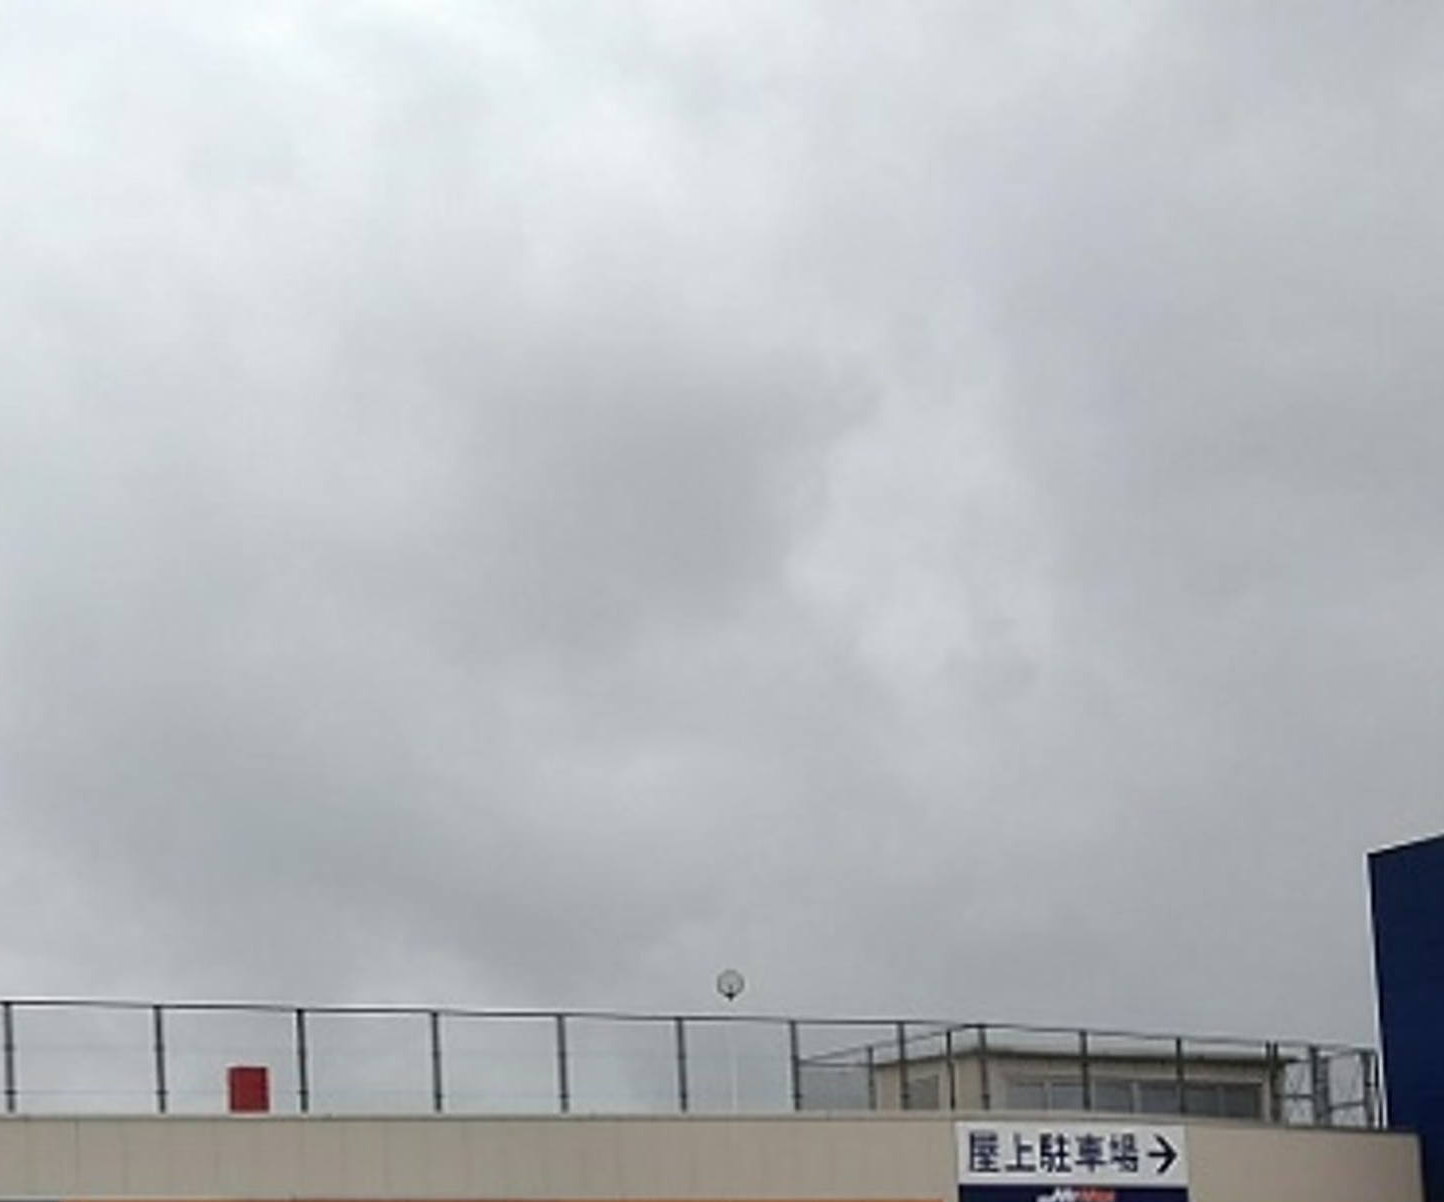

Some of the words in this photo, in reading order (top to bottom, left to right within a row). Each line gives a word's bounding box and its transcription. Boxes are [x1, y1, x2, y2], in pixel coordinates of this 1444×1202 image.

[969, 1131, 1139, 1173] 屋上駐車場
